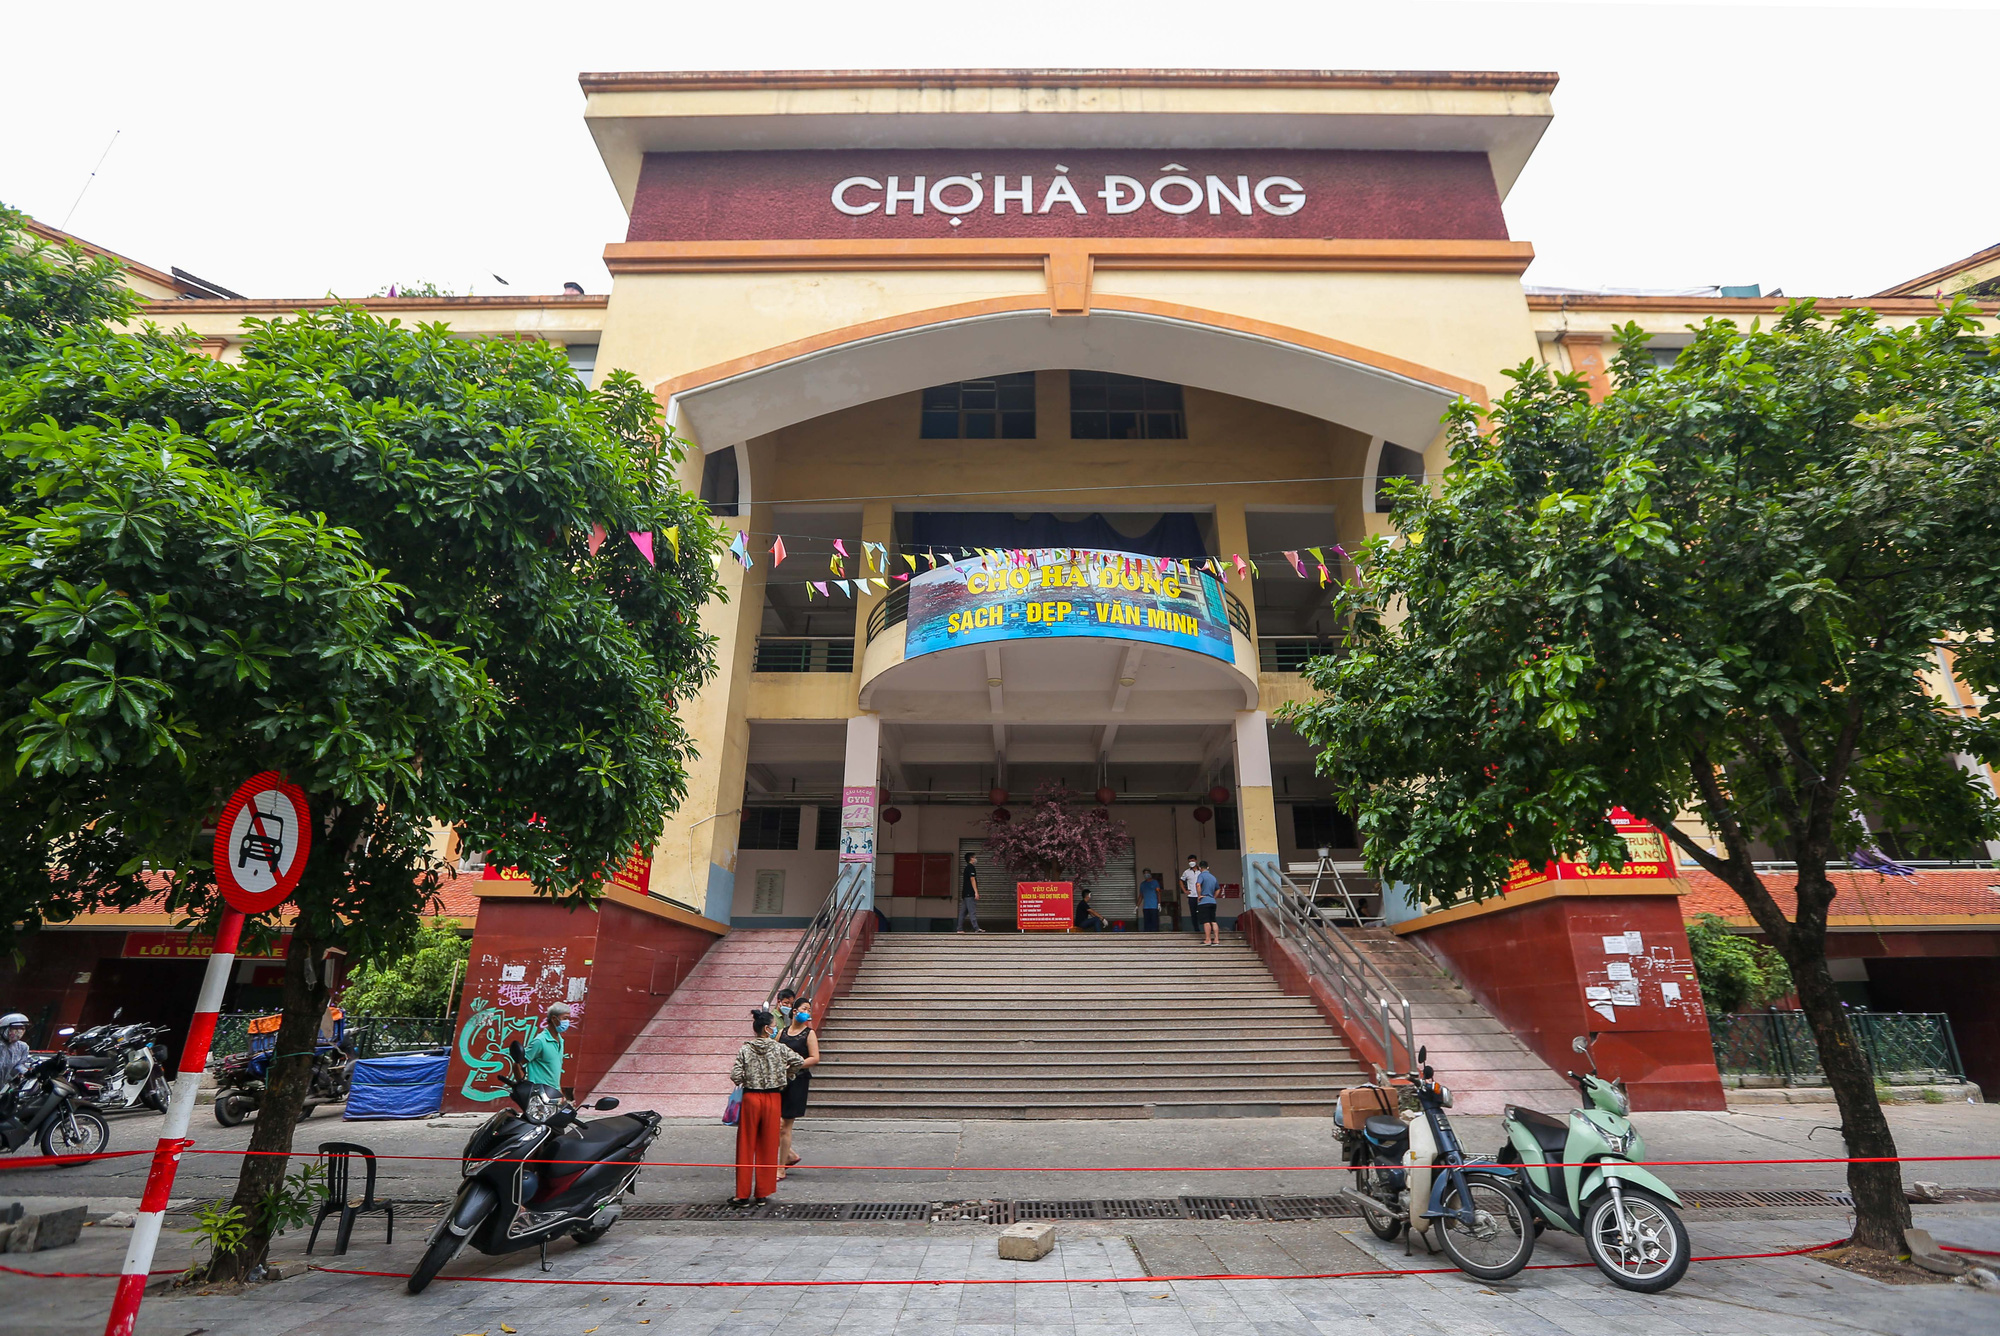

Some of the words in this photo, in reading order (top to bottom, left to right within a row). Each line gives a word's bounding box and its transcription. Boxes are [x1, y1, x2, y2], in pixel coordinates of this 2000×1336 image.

[832, 172, 984, 227] CHỢ
[993, 163, 1088, 215] HÀ
[1097, 163, 1307, 216] ĐÔNG
[966, 563, 1031, 596] CHỢ
[947, 605, 1004, 635] SẠCH
[1026, 601, 1072, 627] ĐẸP
[1096, 599, 1142, 625] VĂN
[1147, 610, 1199, 638] MINH
[847, 796, 871, 804] GYM
[1634, 865, 1659, 876] 9999
[139, 943, 170, 956] LỐI
[176, 943, 213, 956] VÀO
